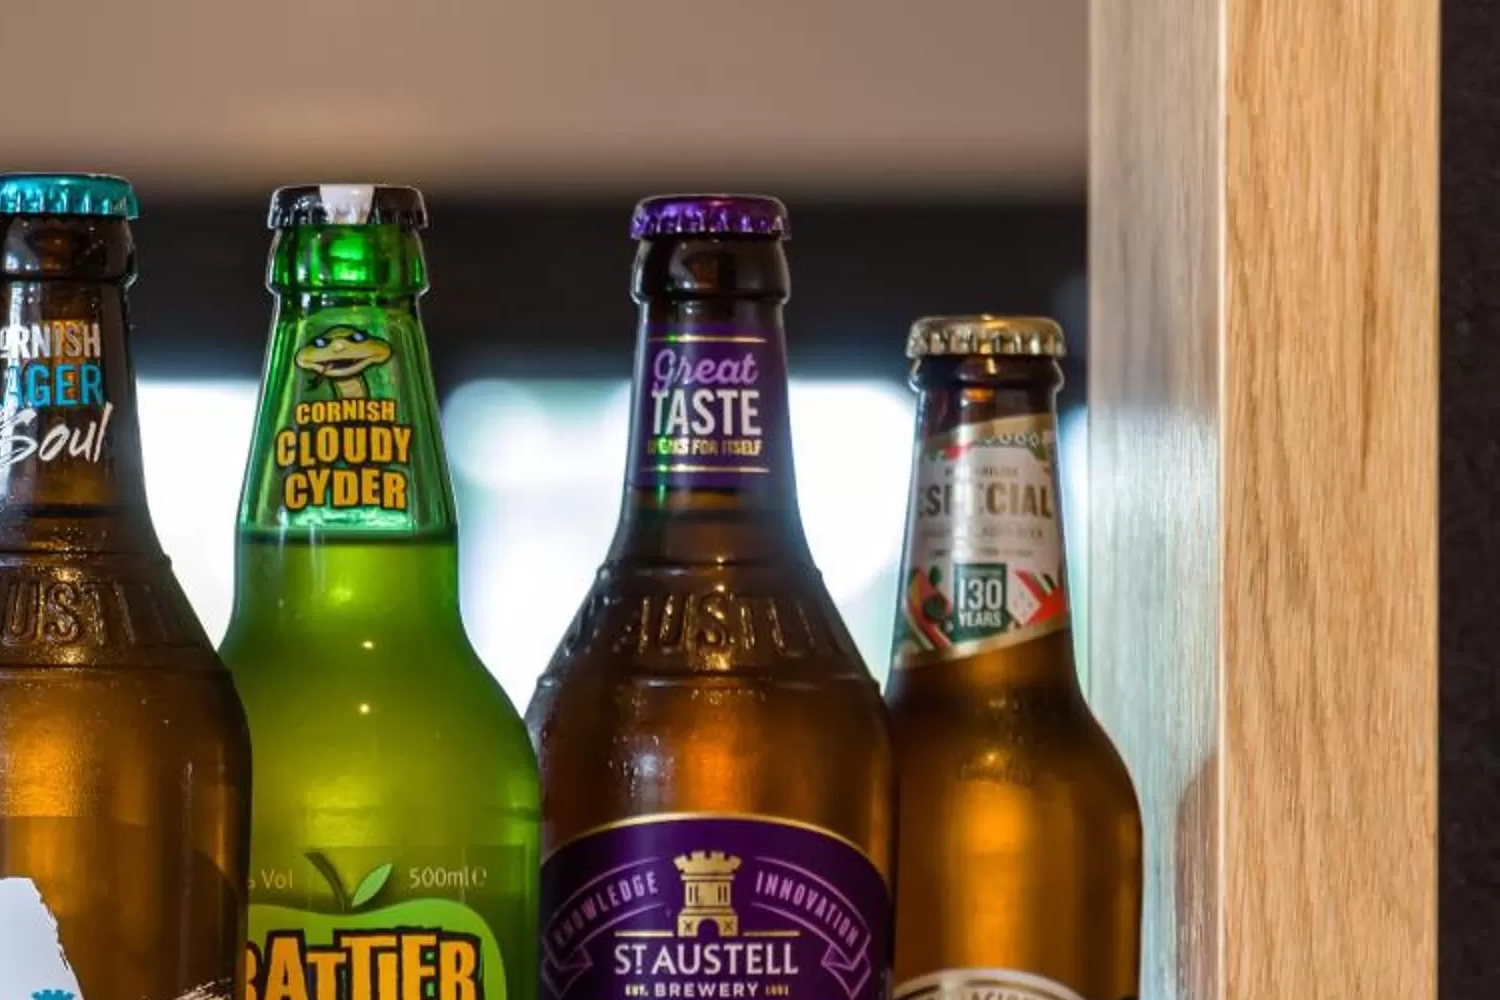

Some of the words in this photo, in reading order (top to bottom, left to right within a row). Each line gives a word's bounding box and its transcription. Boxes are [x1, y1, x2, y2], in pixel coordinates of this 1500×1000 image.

[651, 348, 759, 393] Great
[295, 400, 396, 426] CORNISH
[650, 388, 763, 437] TASTE
[276, 425, 412, 469] CLOUDY
[284, 468, 408, 510] CYDER
[958, 577, 1003, 610] 130
[958, 610, 1003, 629] YEARS
[260, 868, 294, 890] Vol
[755, 870, 861, 948] INNOVATION
[651, 943, 799, 976] AUSTELL
[654, 983, 759, 999] BREWERY
